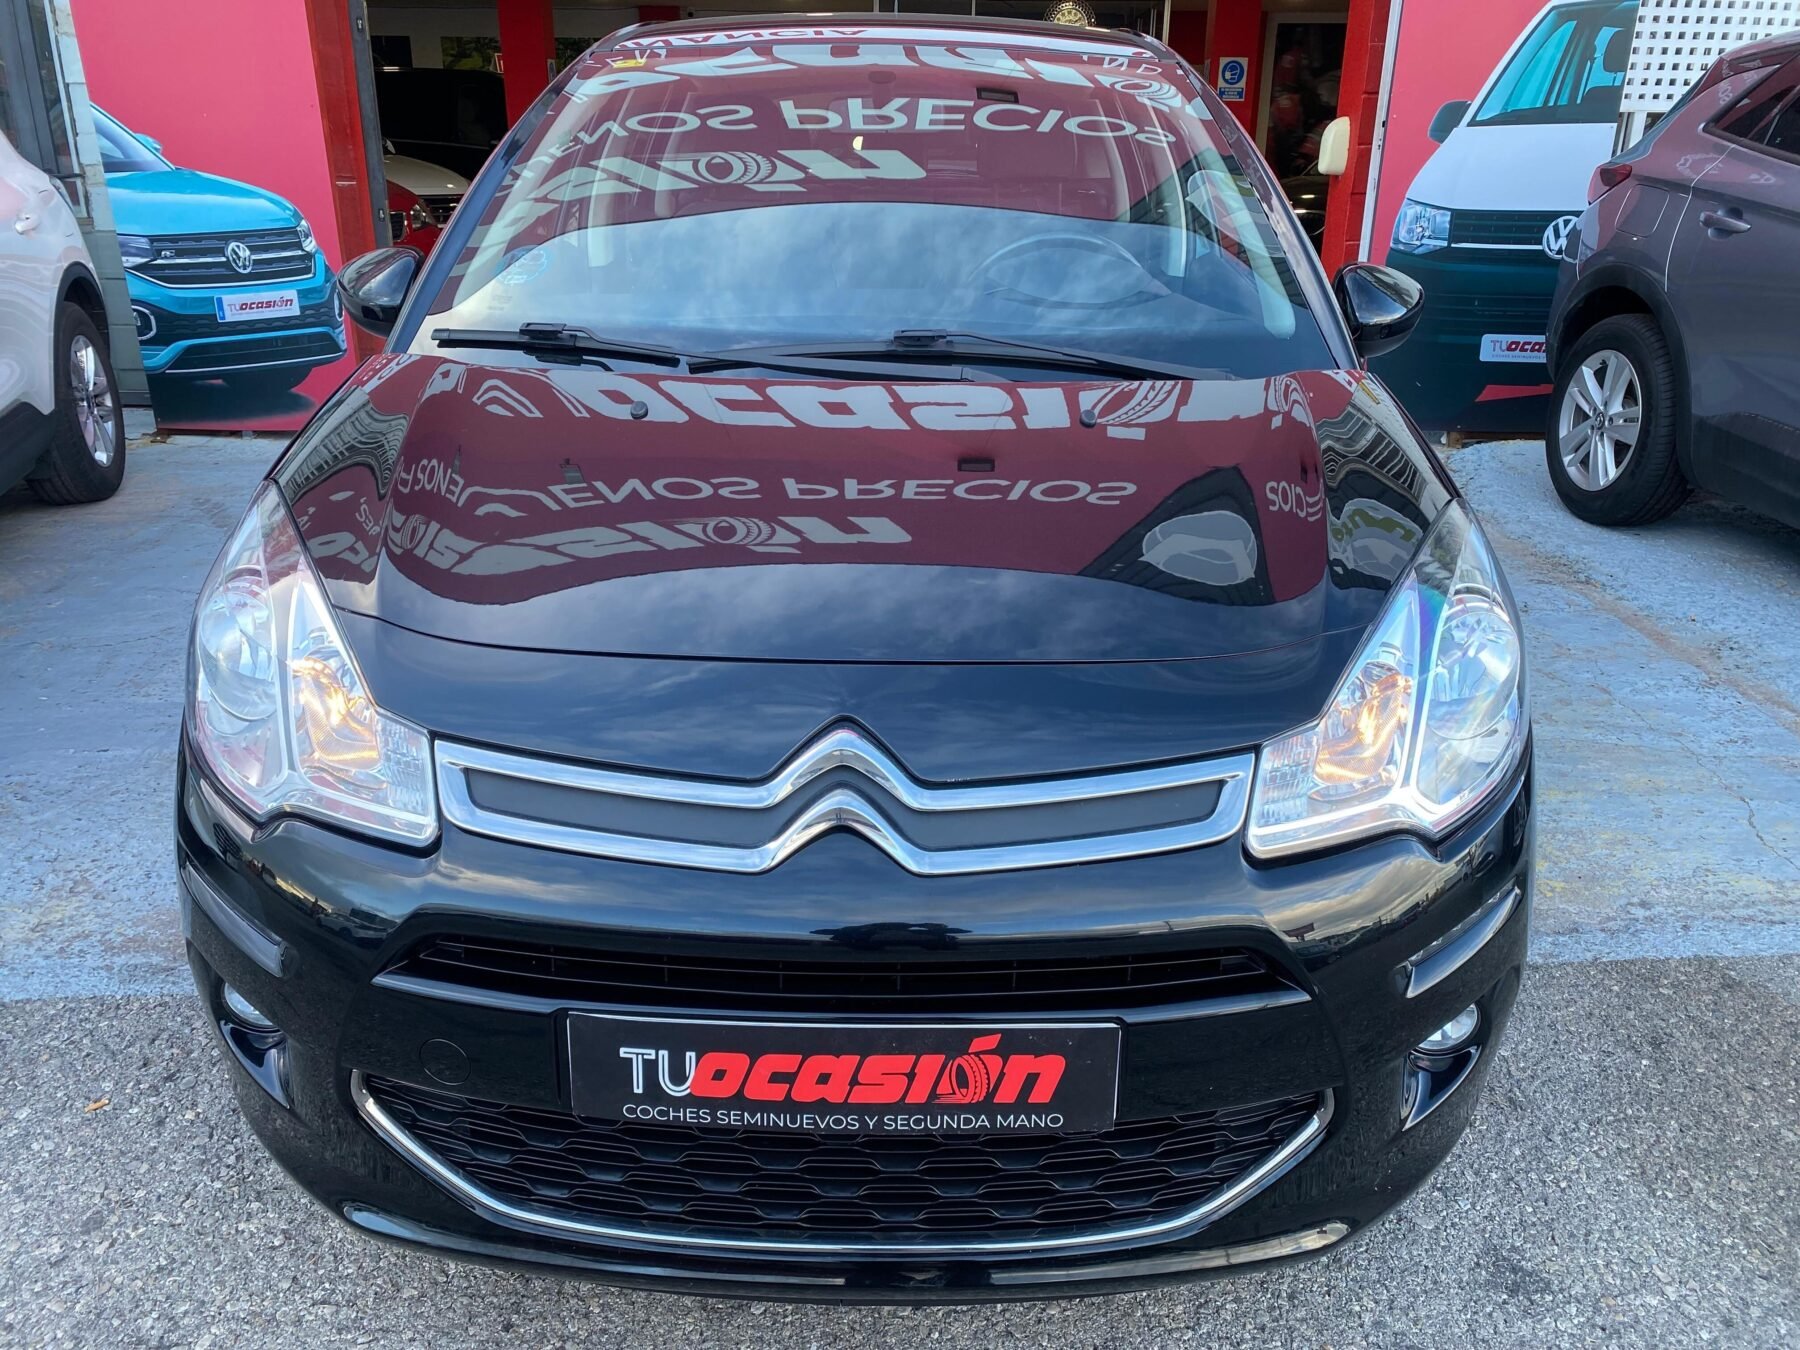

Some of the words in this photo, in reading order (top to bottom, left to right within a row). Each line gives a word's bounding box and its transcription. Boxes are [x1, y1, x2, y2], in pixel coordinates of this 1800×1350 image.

[622, 1104, 711, 1123] COCHES
[716, 1110, 859, 1130] SEMINUEVOS
[864, 1115, 878, 1130] Y
[883, 1114, 991, 1130] SEGUNDA
[996, 1113, 1064, 1129] MANO
